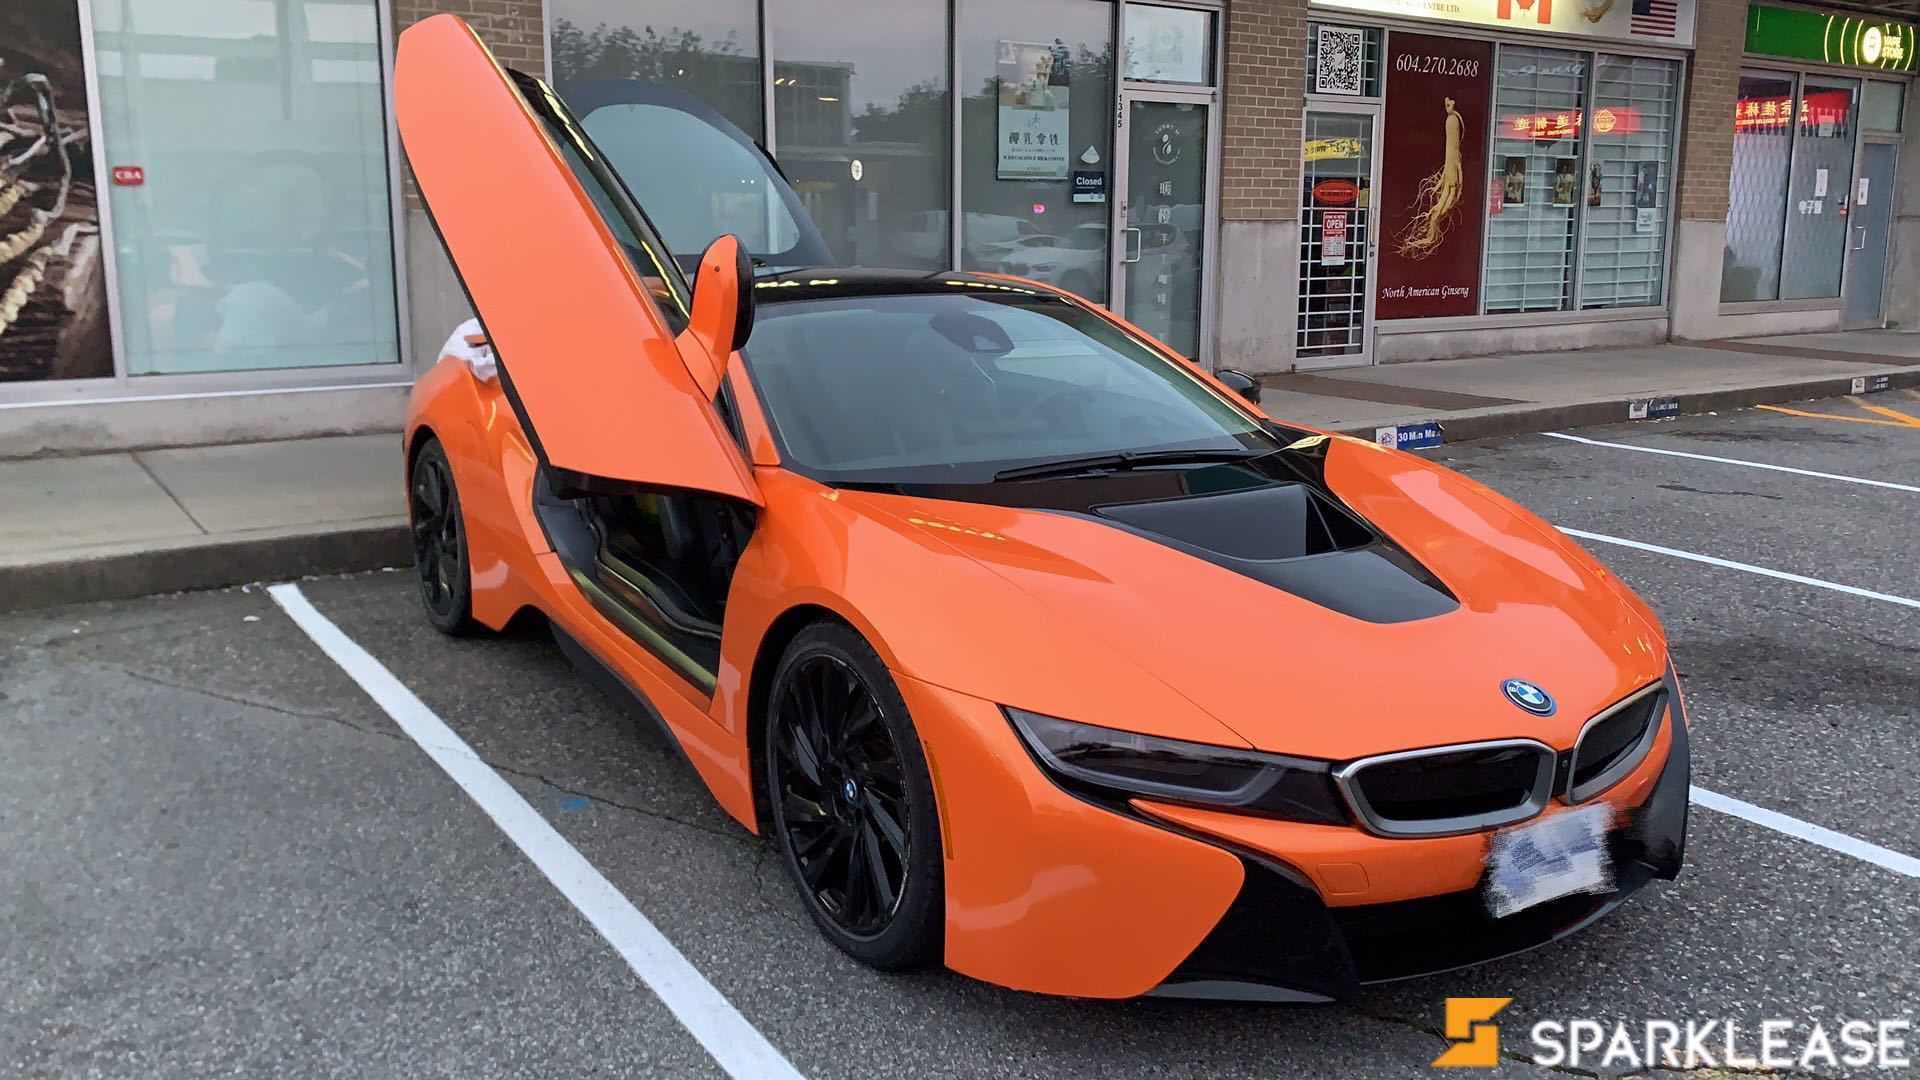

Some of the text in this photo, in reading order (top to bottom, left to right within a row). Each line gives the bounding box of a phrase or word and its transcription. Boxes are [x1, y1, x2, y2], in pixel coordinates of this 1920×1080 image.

[1882, 46, 1904, 60] STORE
[1396, 54, 1479, 77] 604.270.2688
[1076, 177, 1102, 186] Closed
[1326, 219, 1345, 230] OPEN
[1381, 284, 1470, 299] North American Ginseng
[1398, 432, 1408, 442] 30
